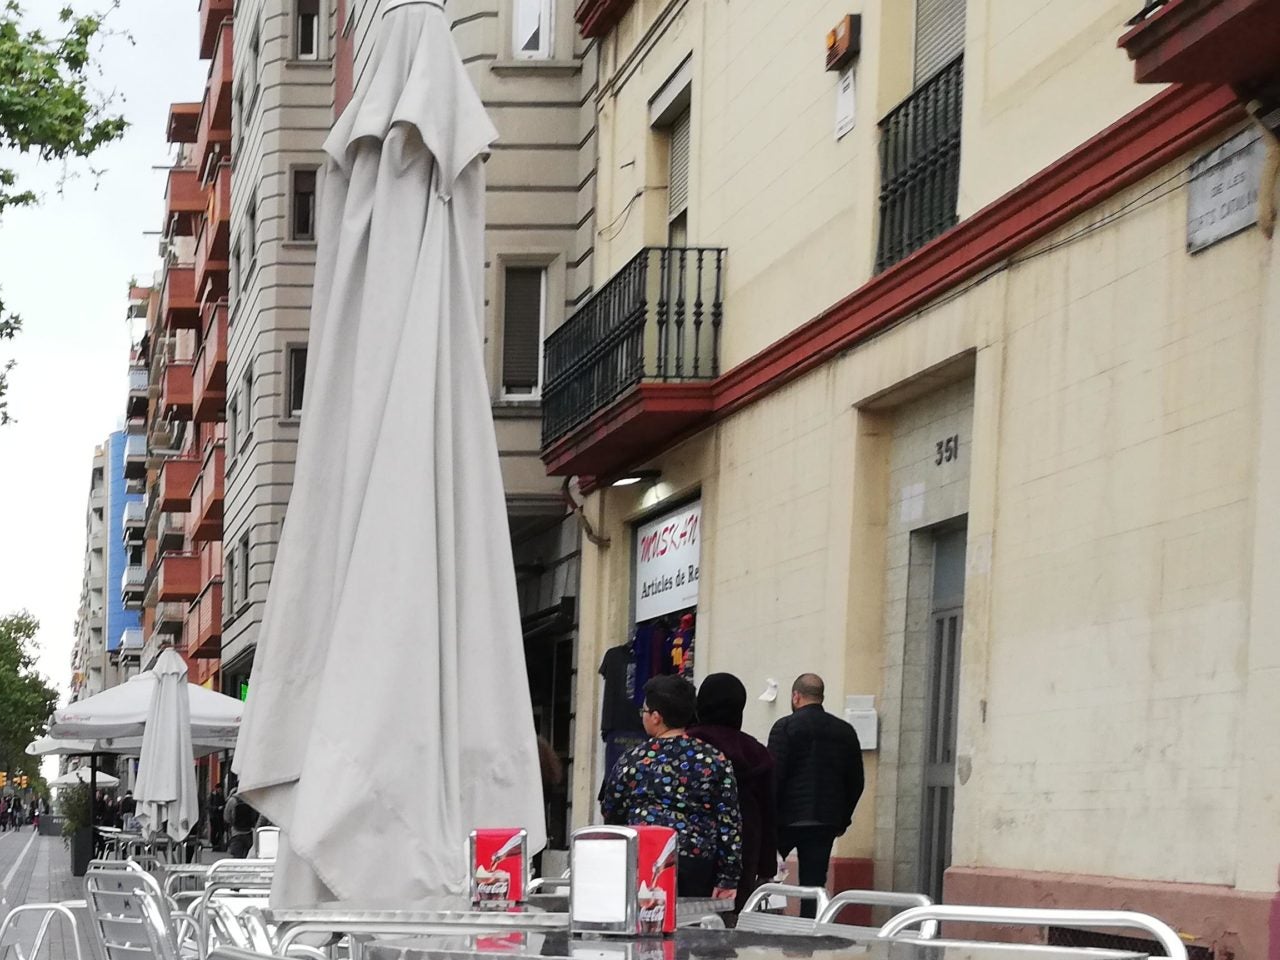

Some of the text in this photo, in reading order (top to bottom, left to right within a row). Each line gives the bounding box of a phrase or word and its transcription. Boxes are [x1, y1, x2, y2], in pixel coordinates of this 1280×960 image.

[935, 433, 959, 467] 351
[641, 574, 673, 600] Articles
[675, 568, 686, 588] de
